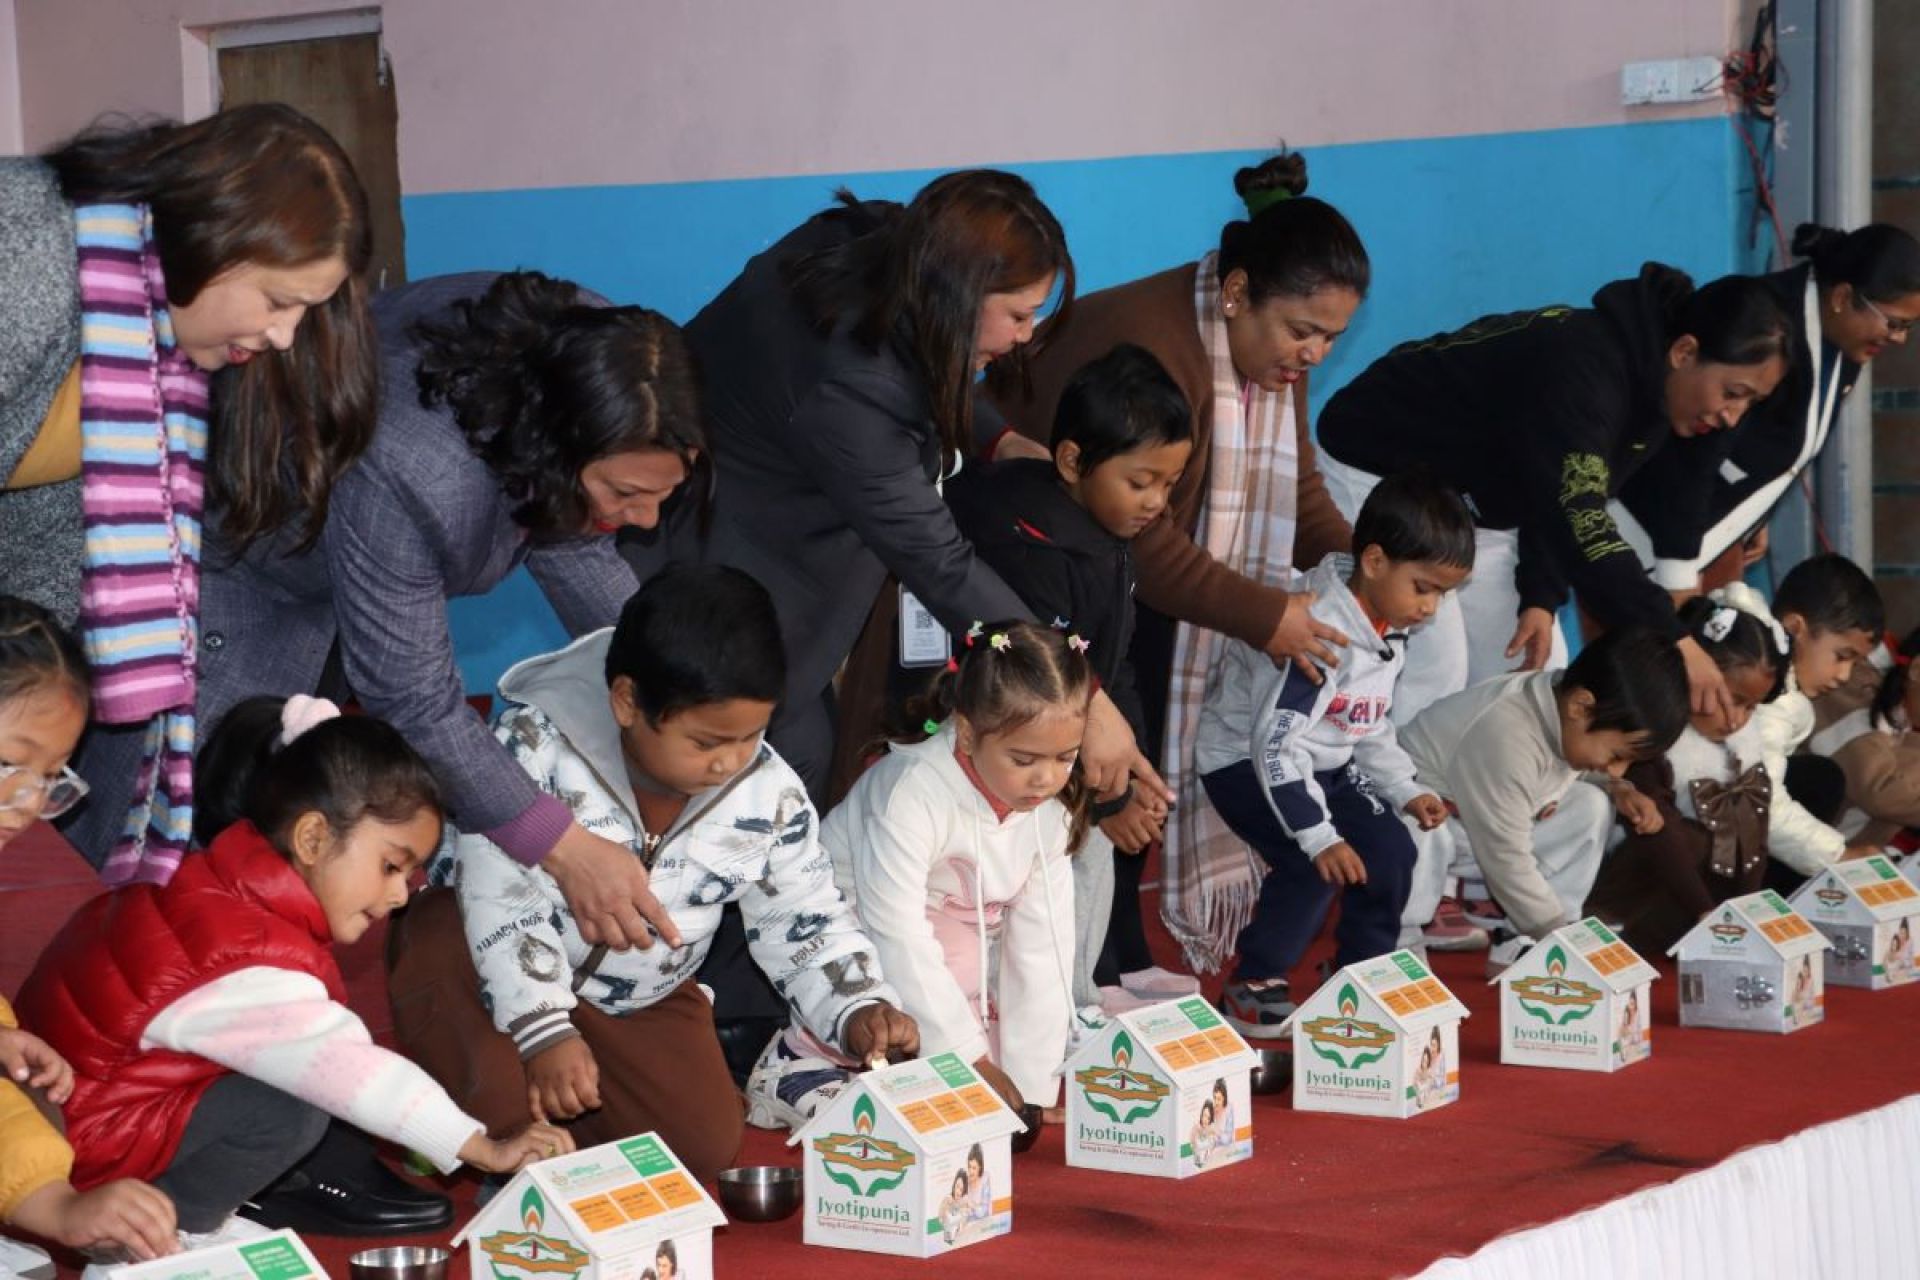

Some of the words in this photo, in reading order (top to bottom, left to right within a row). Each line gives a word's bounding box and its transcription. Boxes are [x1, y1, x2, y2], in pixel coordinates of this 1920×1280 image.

[1306, 1070, 1391, 1092] Jyotipunja
[1079, 1122, 1165, 1149] Jyotipunja
[818, 1196, 910, 1224] Jyotipunja
